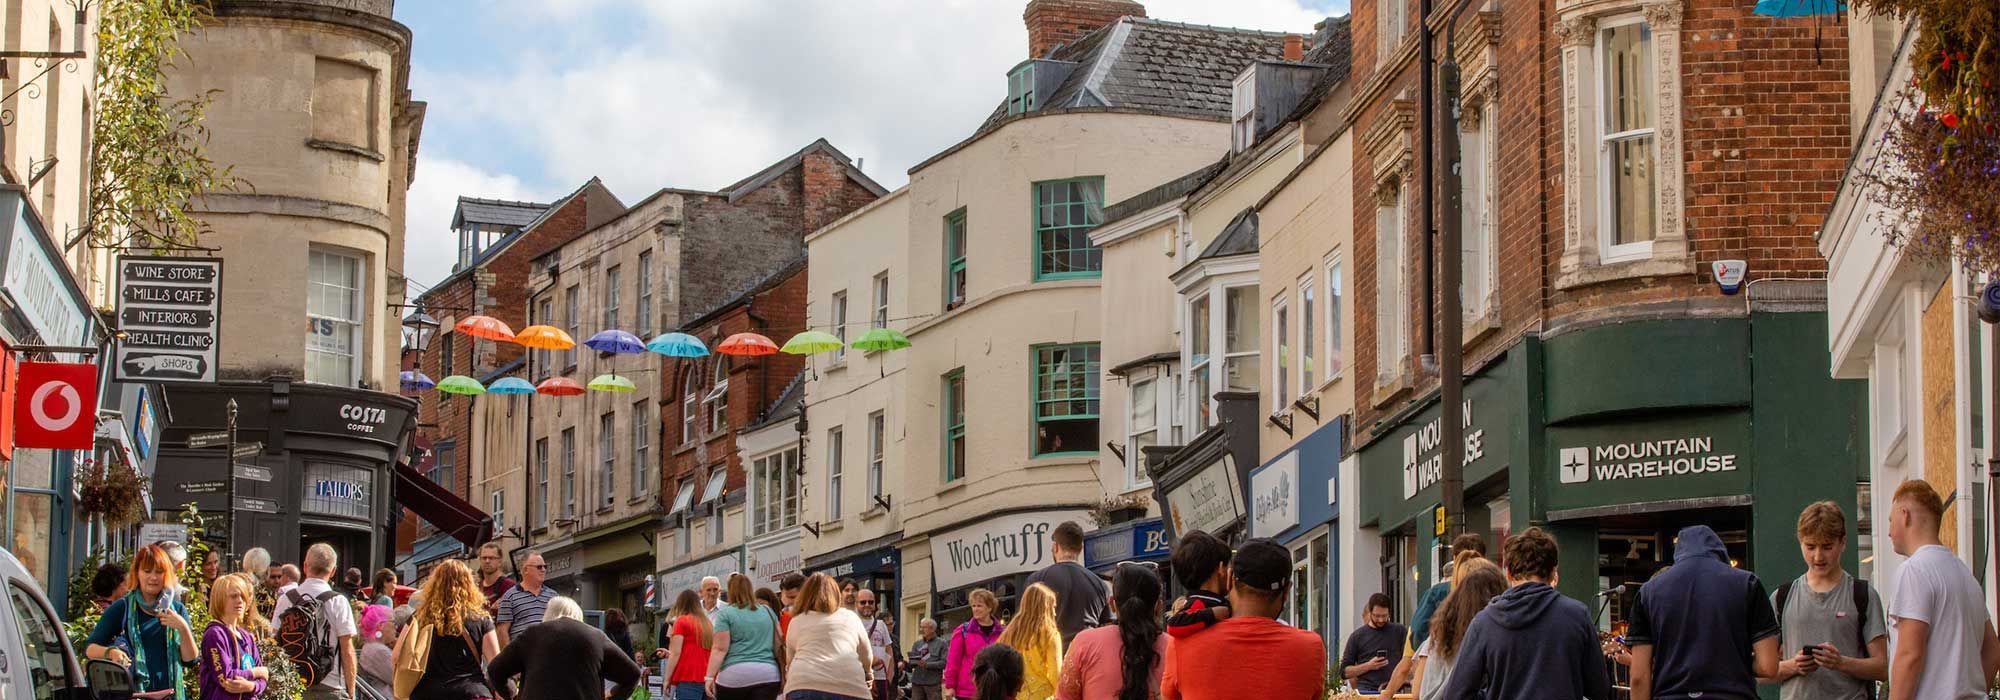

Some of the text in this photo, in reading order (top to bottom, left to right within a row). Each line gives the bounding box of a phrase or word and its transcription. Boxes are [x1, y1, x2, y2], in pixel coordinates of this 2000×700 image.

[135, 266, 205, 280] WINE STORE
[133, 287, 205, 302] MILLS CAFE
[138, 310, 198, 325] INTERIORS
[127, 332, 209, 347] HEALTH CLINIC
[161, 358, 193, 370] SHOPS
[340, 404, 386, 424] COSTA
[347, 423, 374, 433] COFFEE
[1595, 436, 1712, 461] MOUNTAIN
[1594, 454, 1737, 481] WAREHOUSE
[317, 479, 364, 501] TAILORS
[947, 522, 1050, 573] Woodruff
